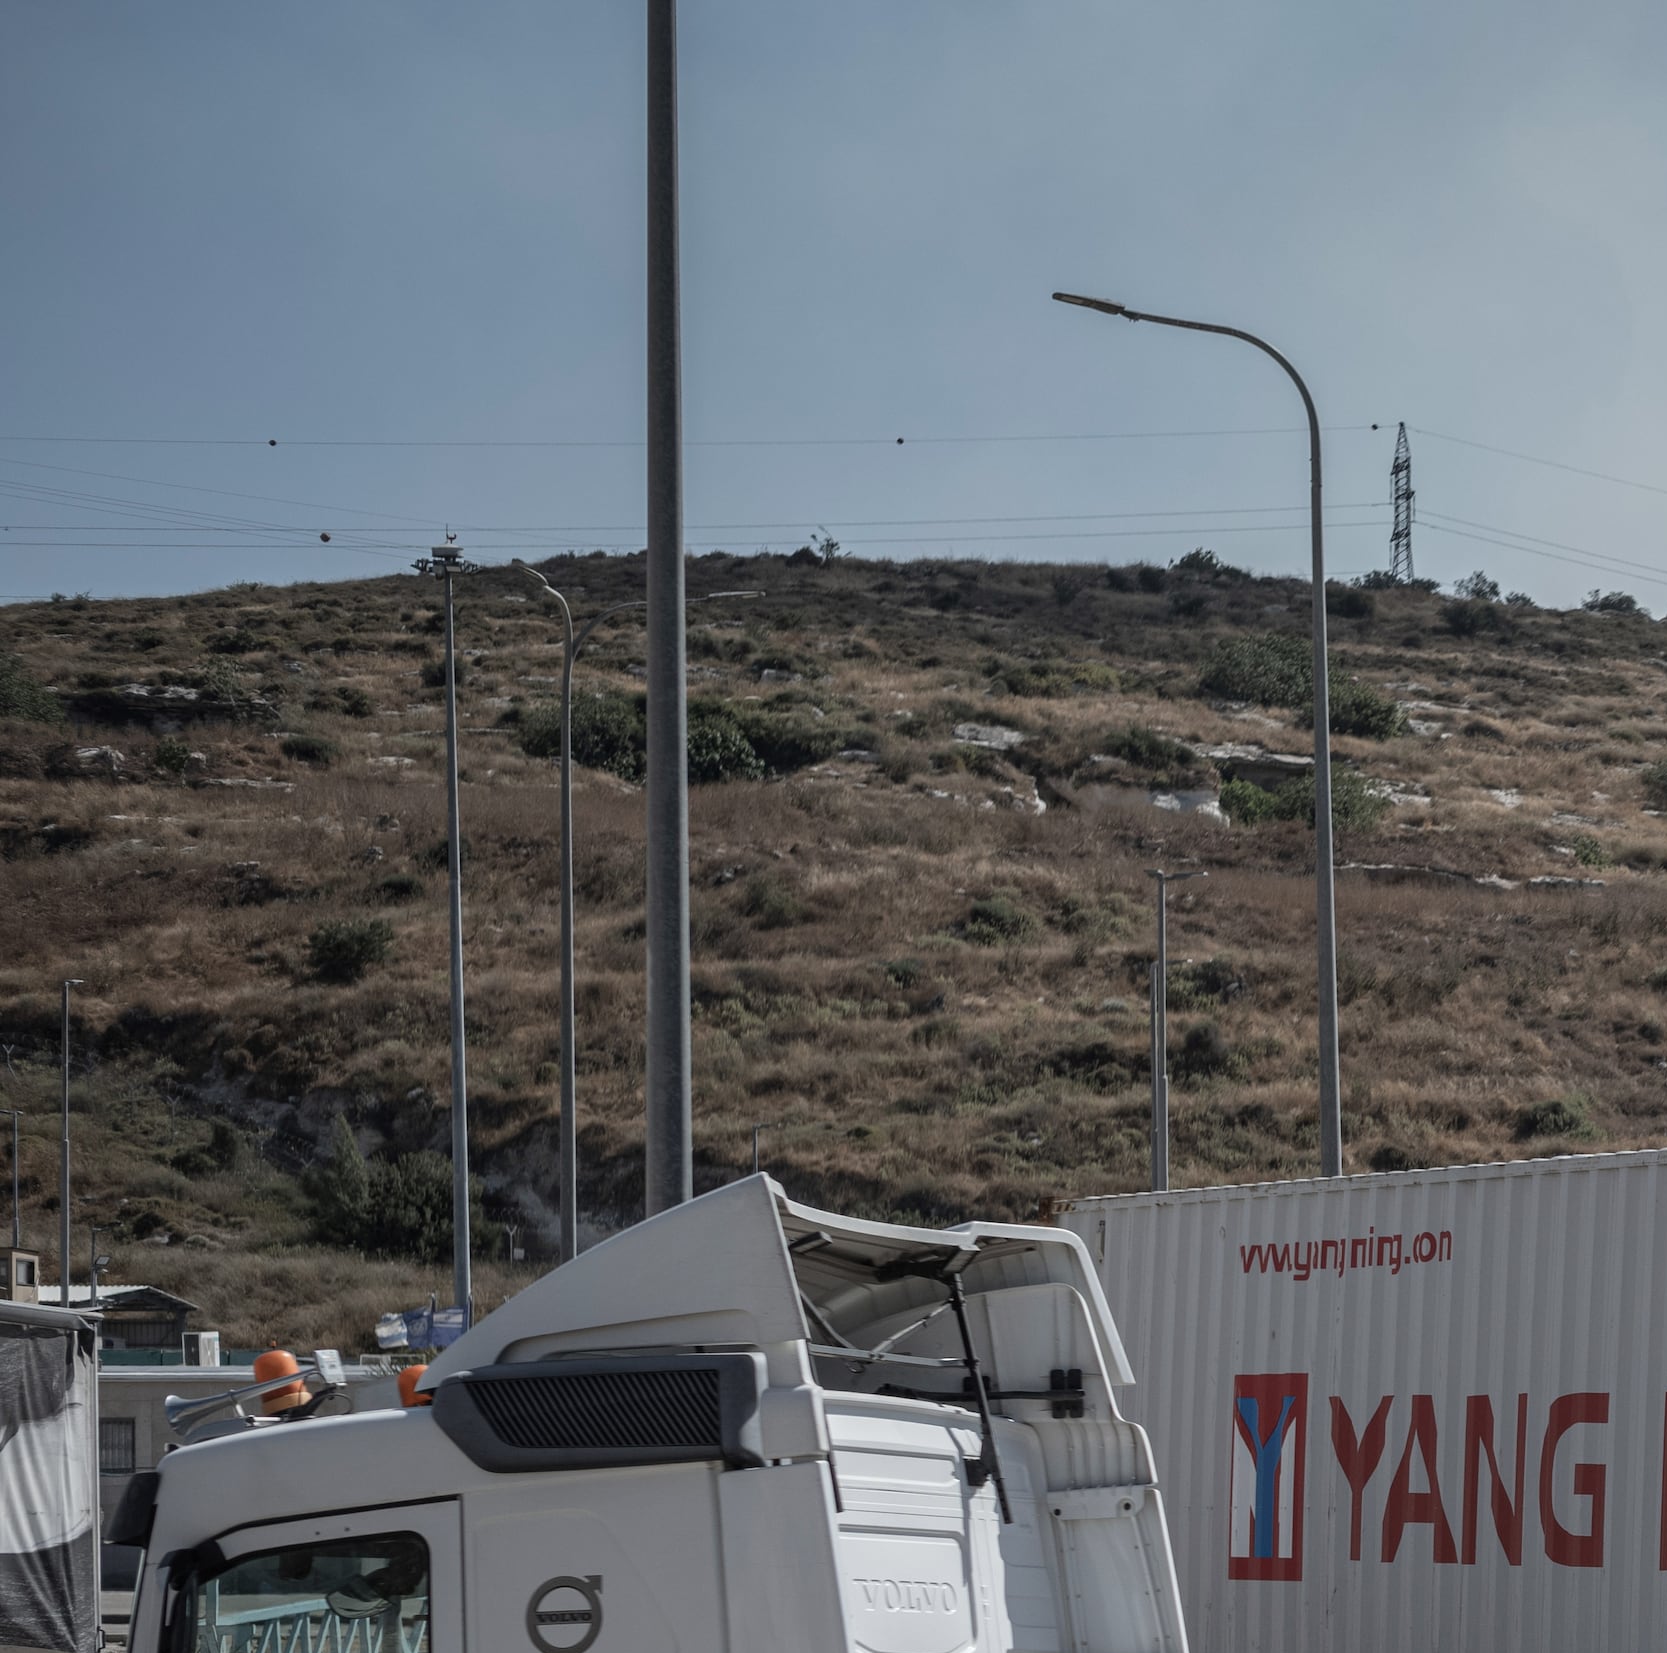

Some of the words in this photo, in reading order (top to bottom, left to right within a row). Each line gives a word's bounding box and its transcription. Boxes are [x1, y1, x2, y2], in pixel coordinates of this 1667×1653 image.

[1329, 1393, 1610, 1569] YANG
[852, 1578, 958, 1615] VOLVO
[536, 1612, 592, 1623] VOLVO
